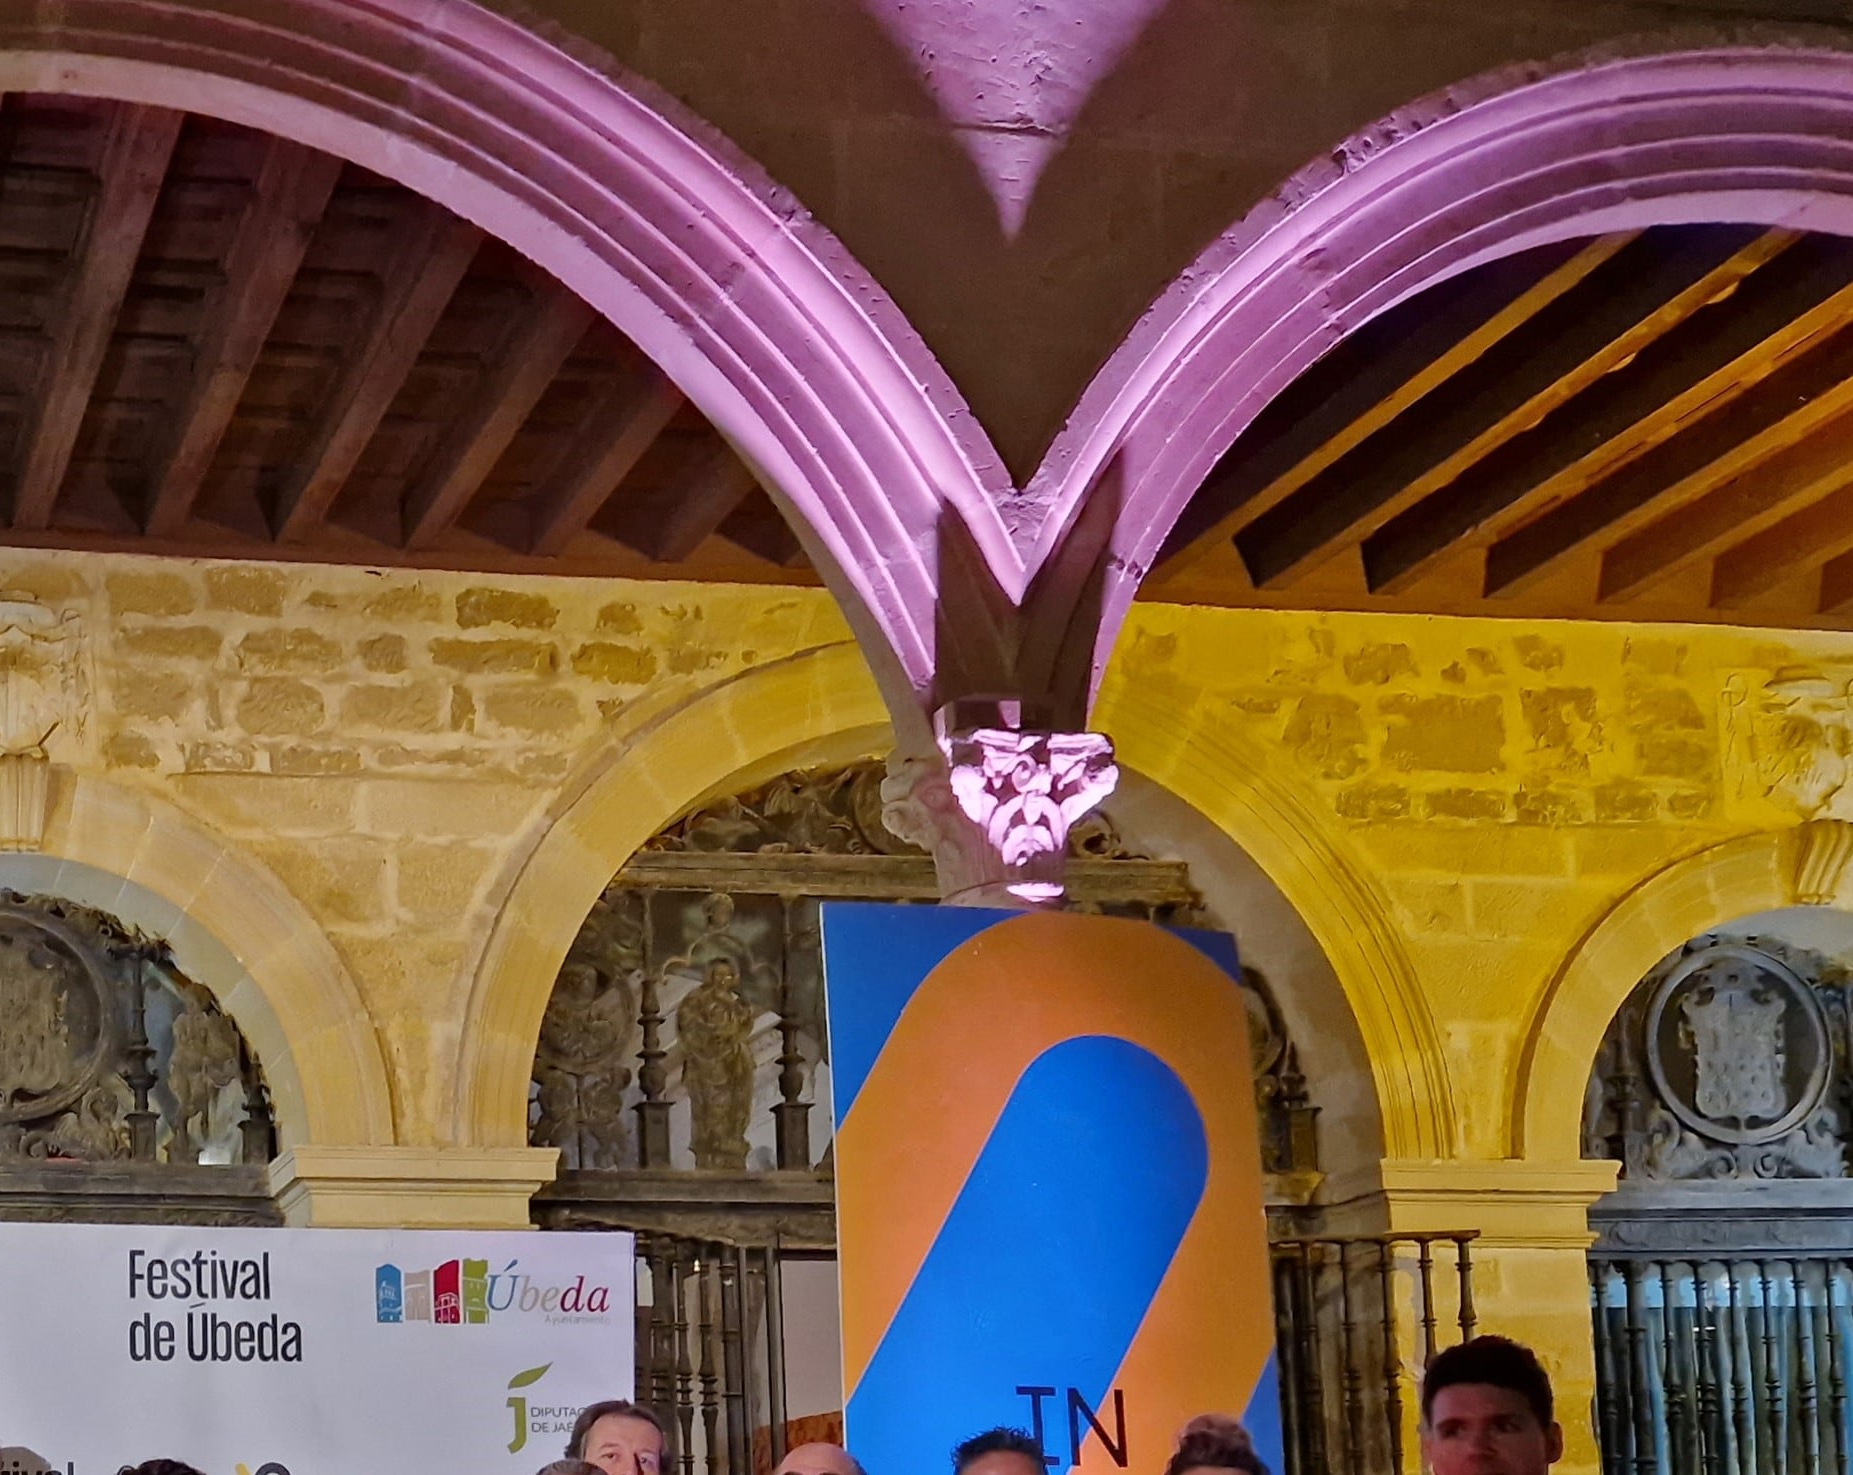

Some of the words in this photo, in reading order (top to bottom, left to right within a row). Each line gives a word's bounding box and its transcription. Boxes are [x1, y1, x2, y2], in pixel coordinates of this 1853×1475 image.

[129, 1250, 271, 1300] Festival
[486, 1259, 610, 1312] Úbeda
[129, 1312, 175, 1362] de
[187, 1302, 302, 1362] Úbeda
[530, 1406, 587, 1418] DIPUTAC
[531, 1422, 549, 1433] DE
[552, 1421, 575, 1433] JAÉ
